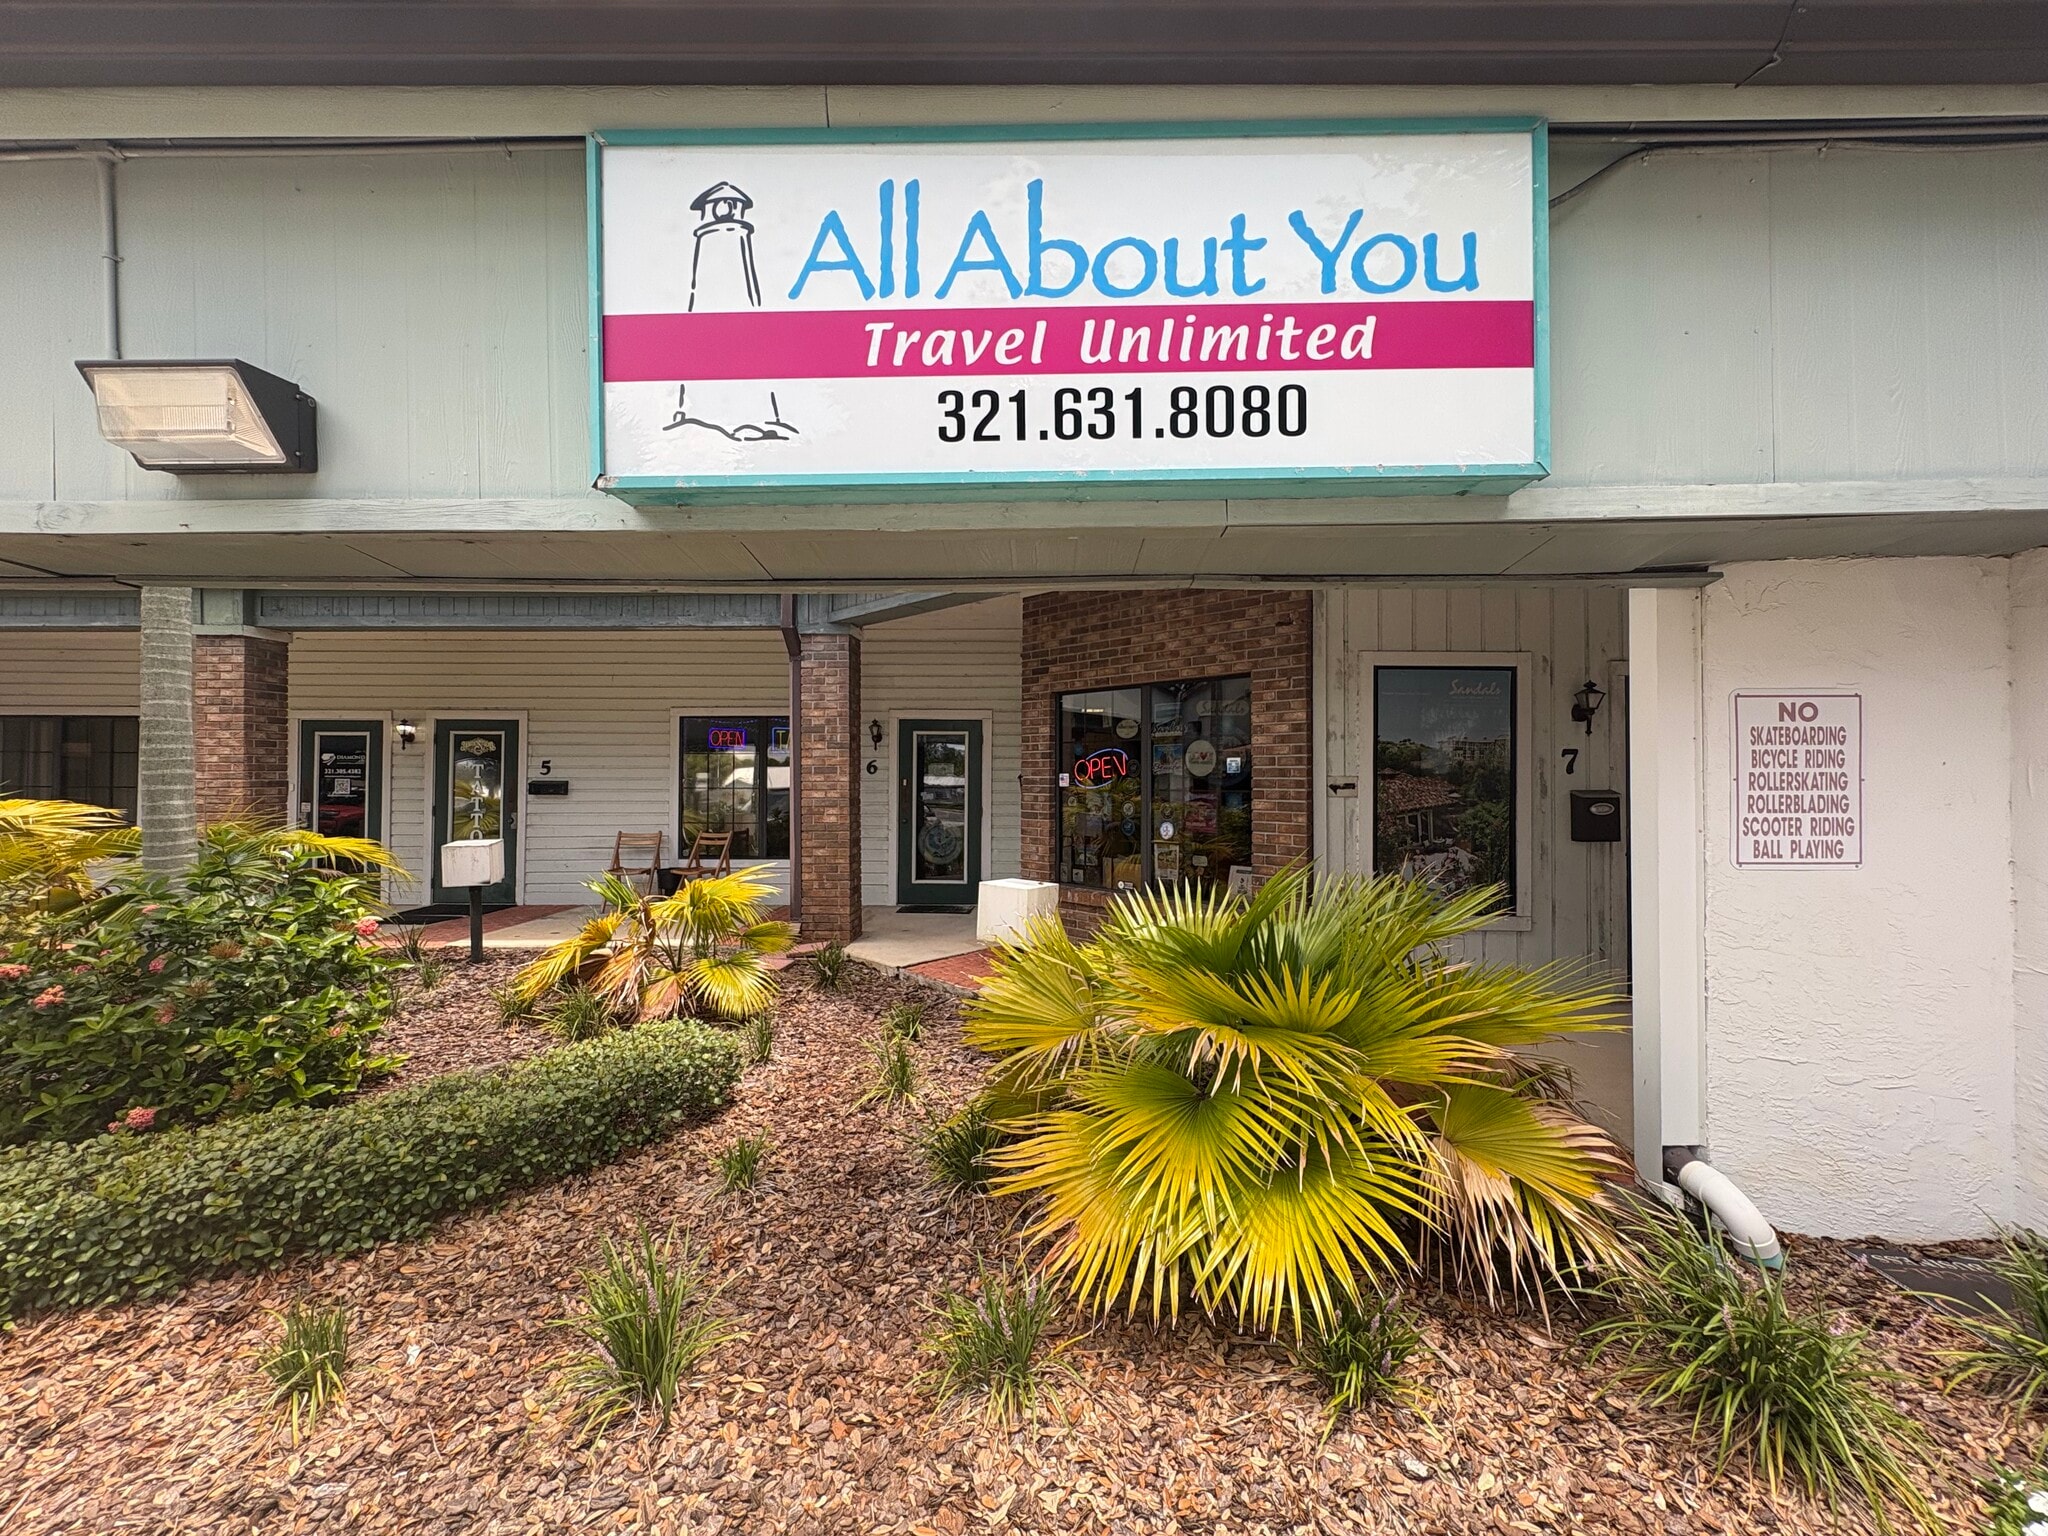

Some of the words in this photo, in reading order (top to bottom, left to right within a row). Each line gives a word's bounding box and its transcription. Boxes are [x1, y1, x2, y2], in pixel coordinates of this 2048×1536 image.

[788, 178, 920, 301] All
[935, 178, 1266, 298] About
[1287, 208, 1479, 294] You
[864, 320, 1044, 367] Travel
[1079, 313, 1378, 363] Unlimited
[937, 384, 1308, 442] 321.631.8080
[1778, 702, 1819, 722] NO
[710, 730, 744, 746] OPEN
[1750, 726, 1847, 746] SKATEBOARDING
[539, 759, 552, 775] 5
[866, 759, 879, 775] 6
[1074, 753, 1127, 781] OPEN
[1561, 748, 1579, 774] 7
[1751, 749, 1798, 769] BICYCLE
[1804, 749, 1846, 769] RIDING
[1748, 771, 1849, 791] ROLLERSKATING
[1747, 794, 1850, 814] ROLLERBLADING
[1742, 816, 1803, 837] SCOOTER
[1809, 816, 1855, 837] RIDING
[1753, 839, 1783, 859] BALL
[1790, 839, 1844, 859] PLAYING
